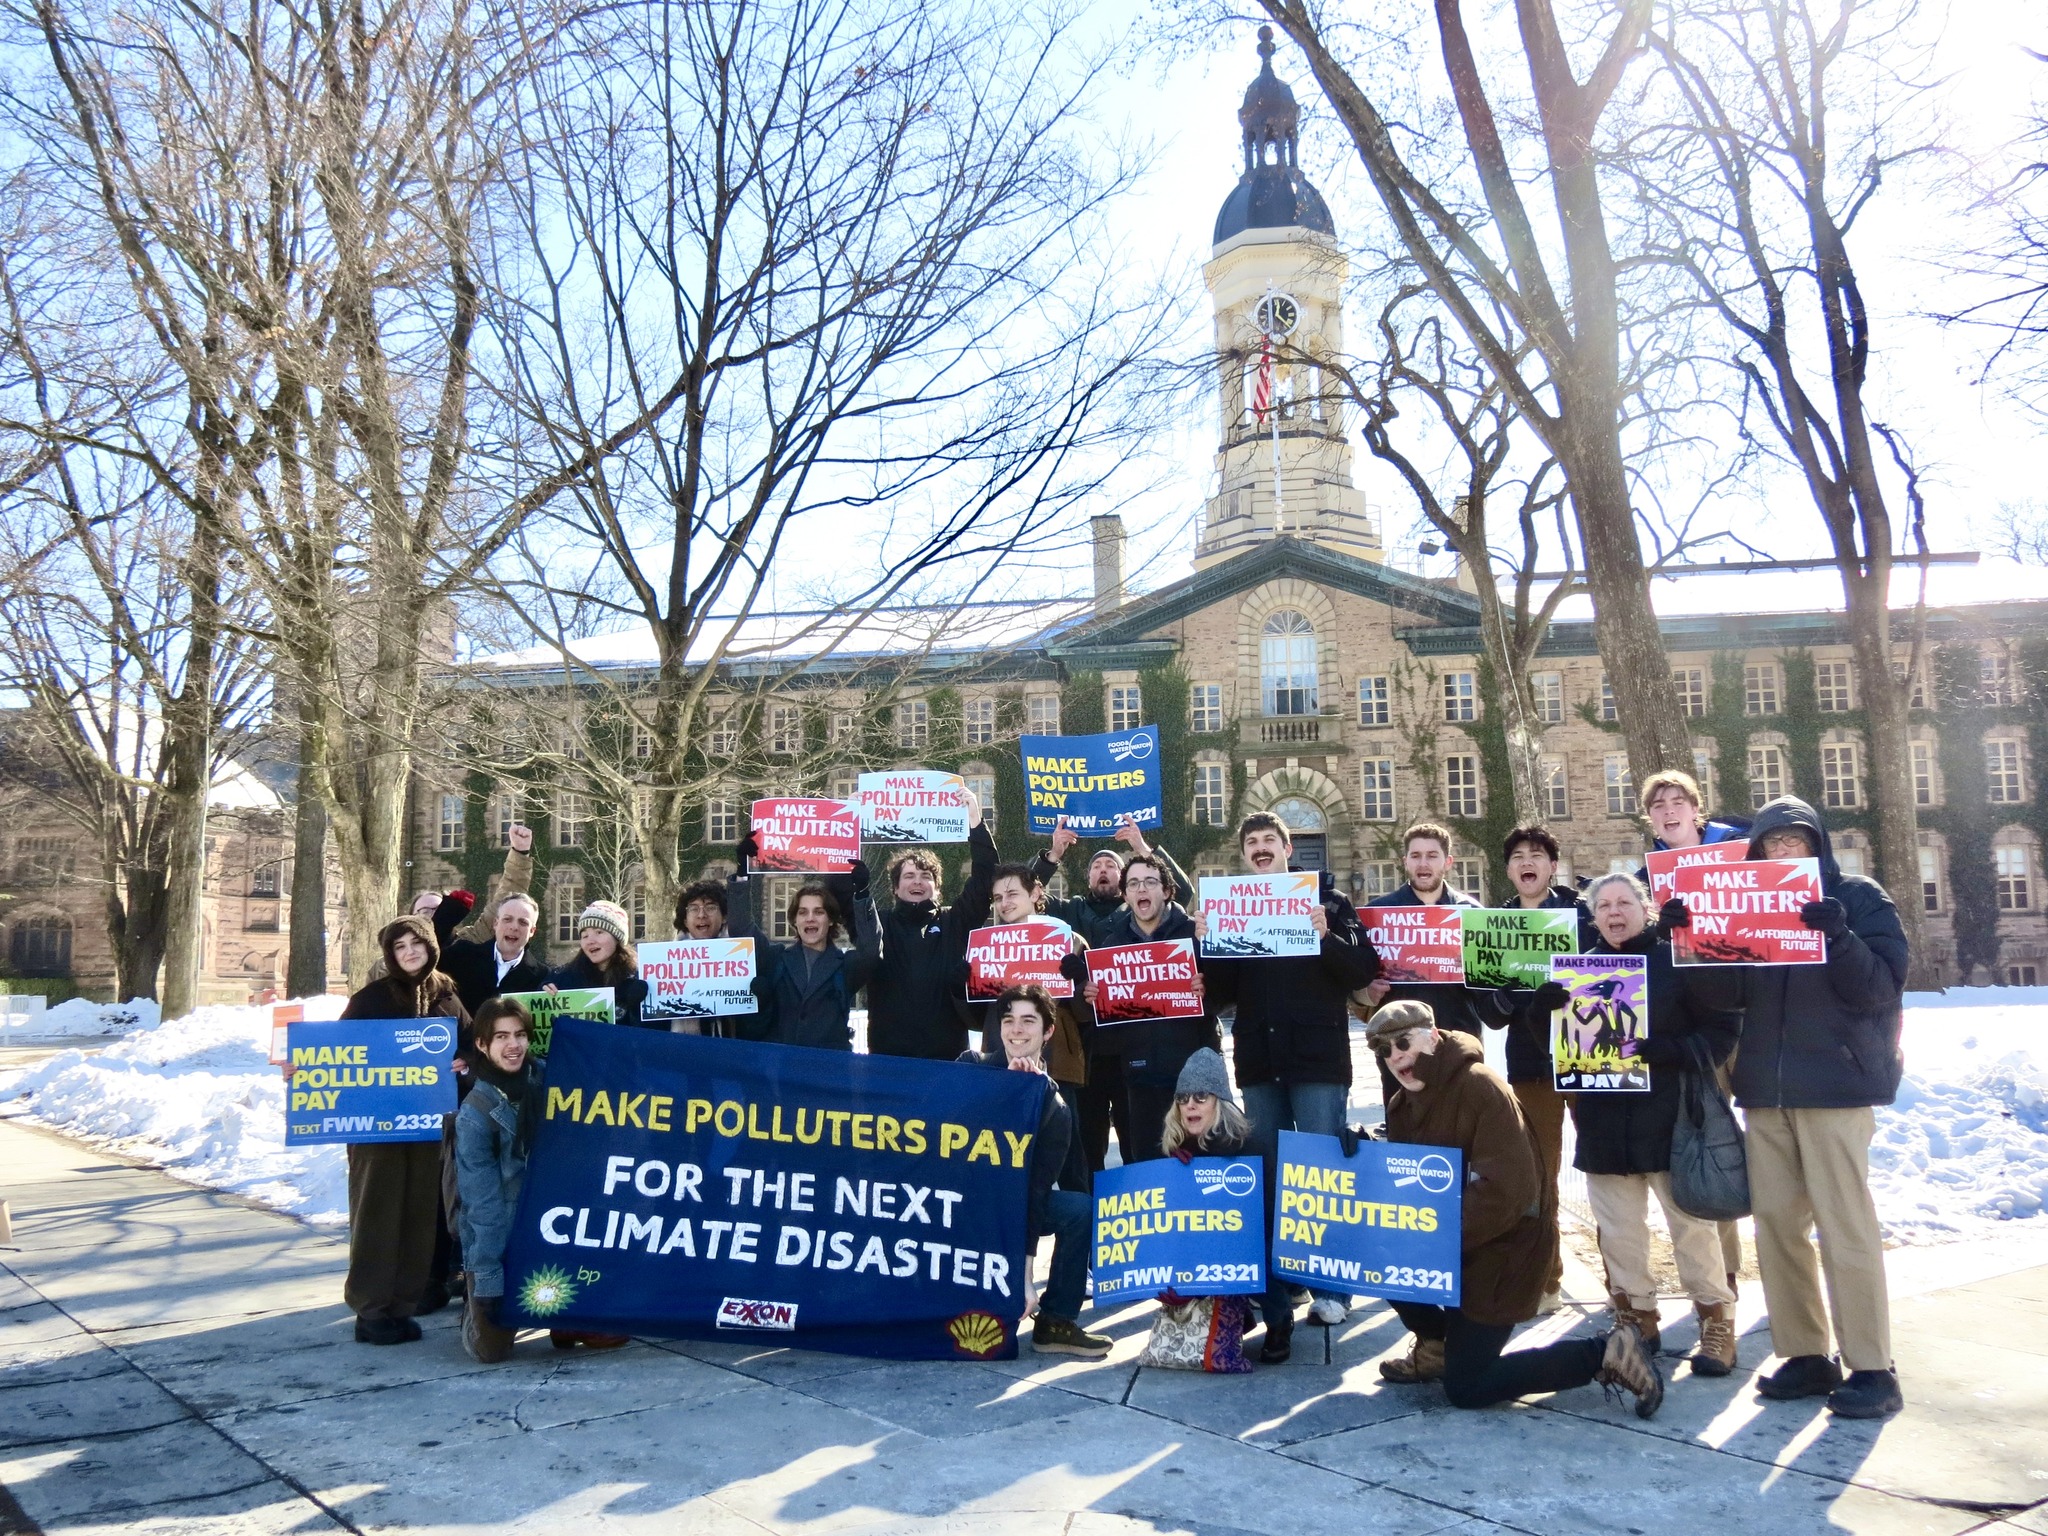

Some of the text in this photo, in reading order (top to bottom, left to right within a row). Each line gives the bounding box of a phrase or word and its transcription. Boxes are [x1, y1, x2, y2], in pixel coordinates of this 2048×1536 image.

[1108, 740, 1129, 748] FOOD&
[1131, 742, 1151, 750] WATCH
[1026, 756, 1088, 774] MAKE
[885, 777, 925, 789] MAKE
[1029, 769, 1145, 792] POLLUTERS
[861, 791, 961, 807] POLLUTERS
[1030, 791, 1067, 809] PAY
[775, 804, 816, 817] MAKE
[875, 807, 902, 821] PAY
[753, 817, 854, 838] POLLUTERS
[919, 817, 964, 826] AFFORDABLE
[1034, 816, 1055, 825] TEXT
[1099, 819, 1112, 828] TO
[763, 835, 793, 851] PAY
[810, 847, 857, 857] AFFORDABLE
[1703, 870, 1758, 890] MAKE
[1230, 882, 1272, 897] MAKE
[1204, 898, 1312, 917] POLLUTERS
[1676, 890, 1811, 914] POLLUTERS
[1218, 918, 1249, 933] PAY
[1382, 912, 1426, 926] MAKE
[1486, 915, 1528, 930] MAKE
[1692, 915, 1730, 935] PAY
[990, 930, 1029, 945] MAKE
[1268, 928, 1316, 937] AFFORDABLE
[1464, 929, 1571, 952] POLLUTERS
[1755, 928, 1819, 941] AFFORDABLE
[1286, 937, 1316, 945] FUTURE
[1781, 940, 1819, 951] FUTURE
[667, 946, 709, 961] MAKE
[968, 944, 1066, 963] POLLUTERS
[1112, 949, 1154, 966] MAKE
[1477, 949, 1505, 966] PAY
[643, 960, 749, 980] POLLUTERS
[980, 963, 1008, 978] PAY
[1554, 957, 1644, 969] MAKE POLLUTERS
[1092, 962, 1192, 985] POLLUTERS
[657, 981, 687, 996] PAY
[1042, 980, 1069, 988] FUTURE
[724, 997, 754, 1005] FUTURE
[1107, 985, 1135, 1001] PAY
[530, 996, 570, 1011] MAKE
[395, 1029, 421, 1037] FOOD&
[423, 1035, 449, 1043] WATCH
[293, 1045, 368, 1066] MAKE
[292, 1066, 438, 1090] POLLUTERS
[1581, 1074, 1623, 1088] PAY
[291, 1090, 341, 1111] PAY
[292, 1113, 444, 1135] TEXT FWW TO 2332
[546, 1086, 1033, 1168] MAKE POLLUTERS PAY
[1386, 1157, 1418, 1166] FOOD&
[1282, 1162, 1356, 1196] MAKE
[1387, 1166, 1450, 1179] WATER WATCH
[603, 1155, 963, 1228] FOR THE NEXT
[1098, 1187, 1166, 1219] MAKE
[1280, 1189, 1438, 1232] POLLUTERS
[1097, 1209, 1243, 1243] POLLUTERS
[1279, 1216, 1328, 1247] PAY
[539, 1206, 1011, 1297] CLIMATE DISASTER
[1097, 1239, 1140, 1268] PAY
[577, 1265, 600, 1286] bp
[1097, 1278, 1122, 1293] TEXT
[1123, 1266, 1174, 1288] FWW
[1175, 1271, 1193, 1283] TO
[1195, 1264, 1259, 1282] 23321
[1278, 1256, 1307, 1272] TEXT
[1308, 1255, 1361, 1280] FWW
[1363, 1270, 1382, 1284] TO
[1384, 1265, 1453, 1291] 23321
